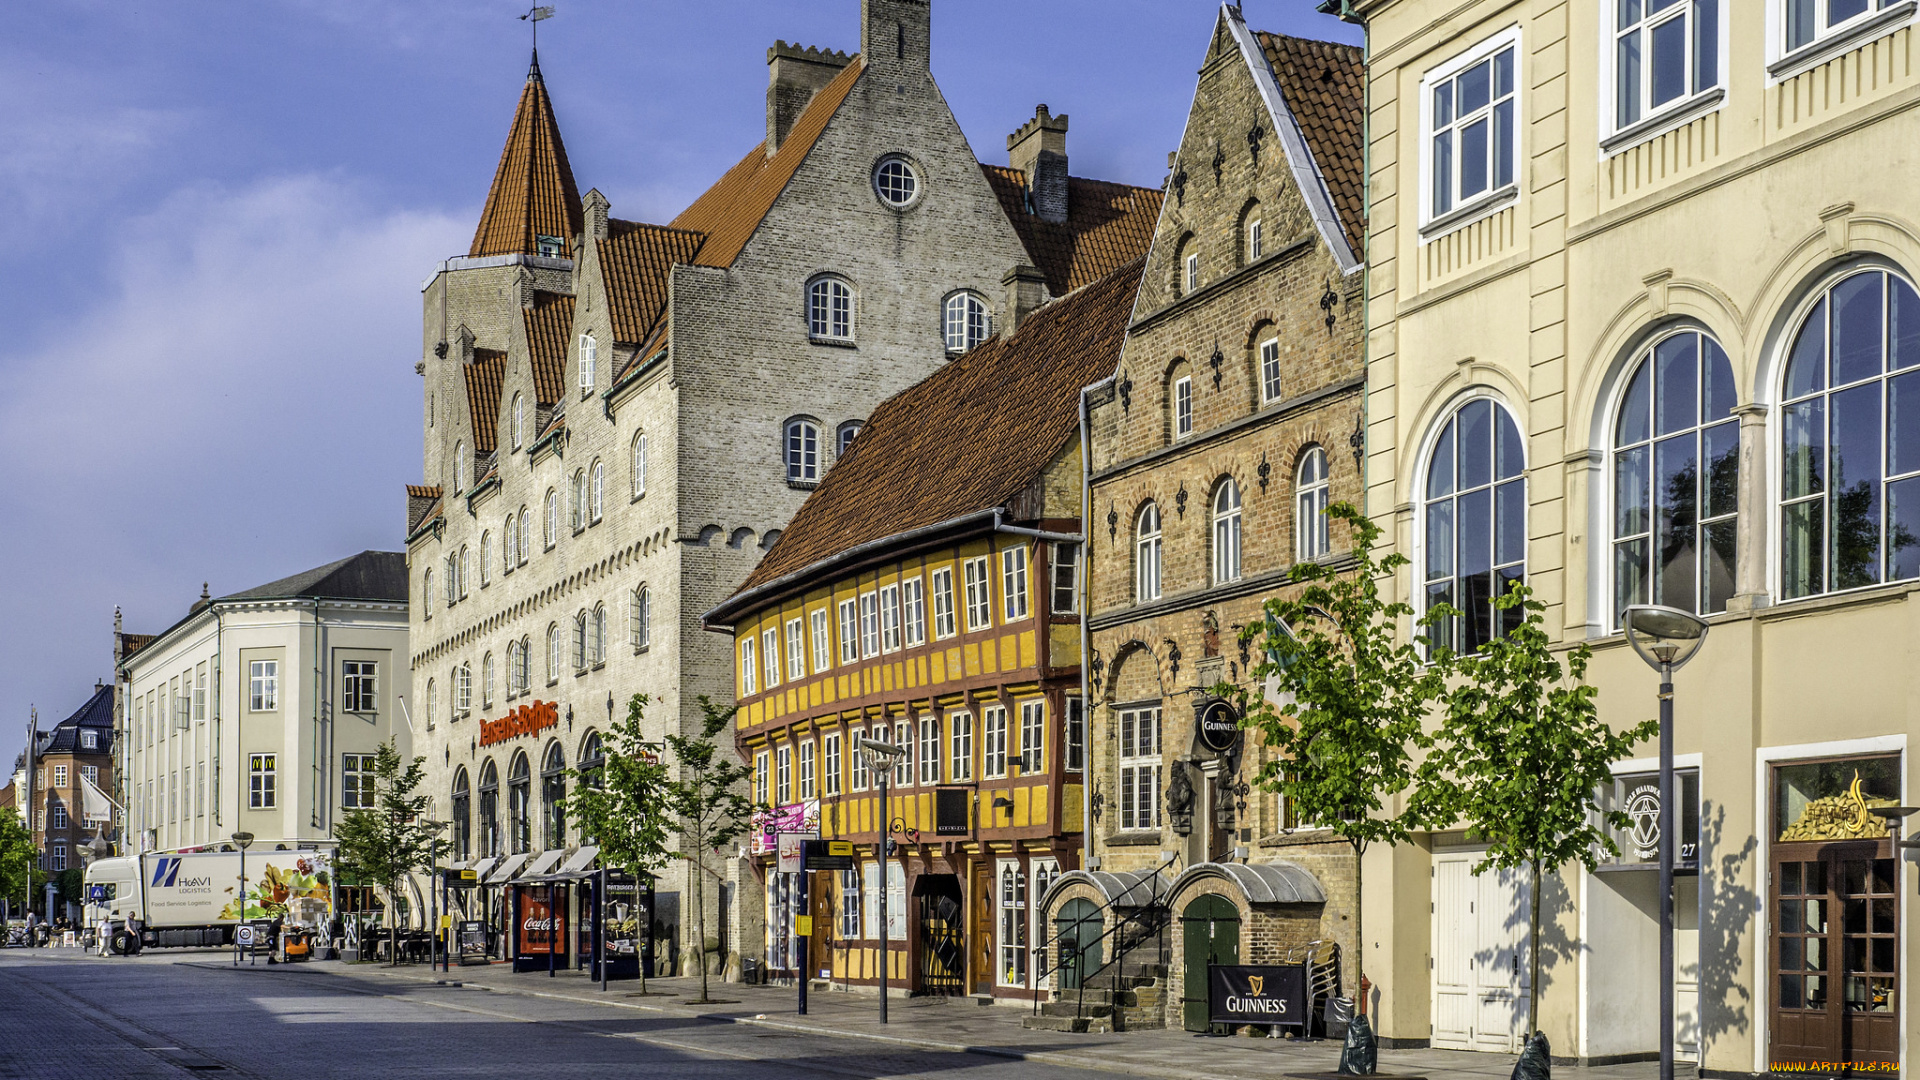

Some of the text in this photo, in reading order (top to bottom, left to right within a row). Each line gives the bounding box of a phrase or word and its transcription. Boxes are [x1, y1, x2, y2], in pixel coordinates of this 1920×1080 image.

[1204, 721, 1237, 731] GUINNESS
[1681, 843, 1696, 857] 27
[1226, 995, 1286, 1014] GUINNESS
